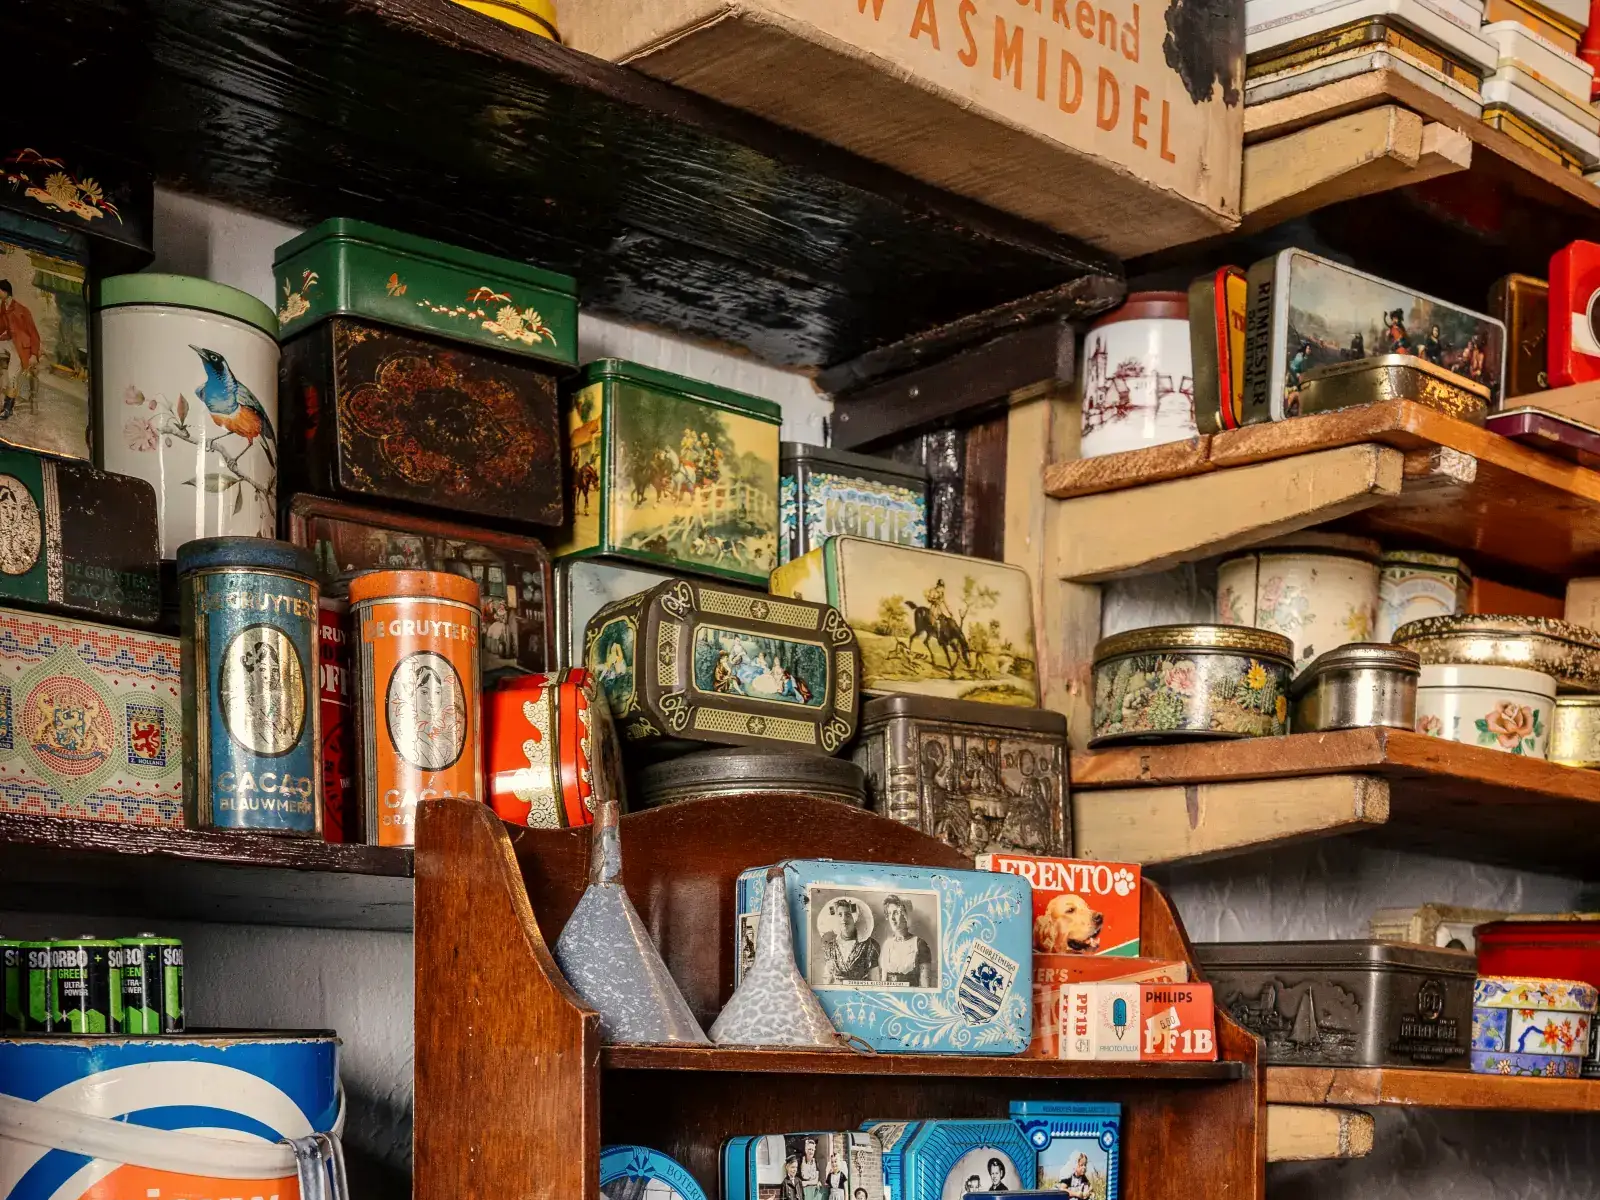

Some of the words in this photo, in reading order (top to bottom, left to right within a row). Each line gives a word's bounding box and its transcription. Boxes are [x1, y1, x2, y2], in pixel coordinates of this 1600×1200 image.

[1015, 0, 1140, 63] kend
[217, 770, 313, 799] CACAO
[383, 812, 415, 827] ORA
[998, 858, 1113, 896] FRENTO
[50, 950, 88, 968] ORBO
[58, 968, 89, 979] GREEN
[1033, 968, 1069, 983] ER'S
[63, 988, 89, 997] POWER
[1145, 991, 1193, 1004] PHILIPS
[1075, 993, 1088, 1037] PF1B
[1143, 1029, 1213, 1054] PF1B
